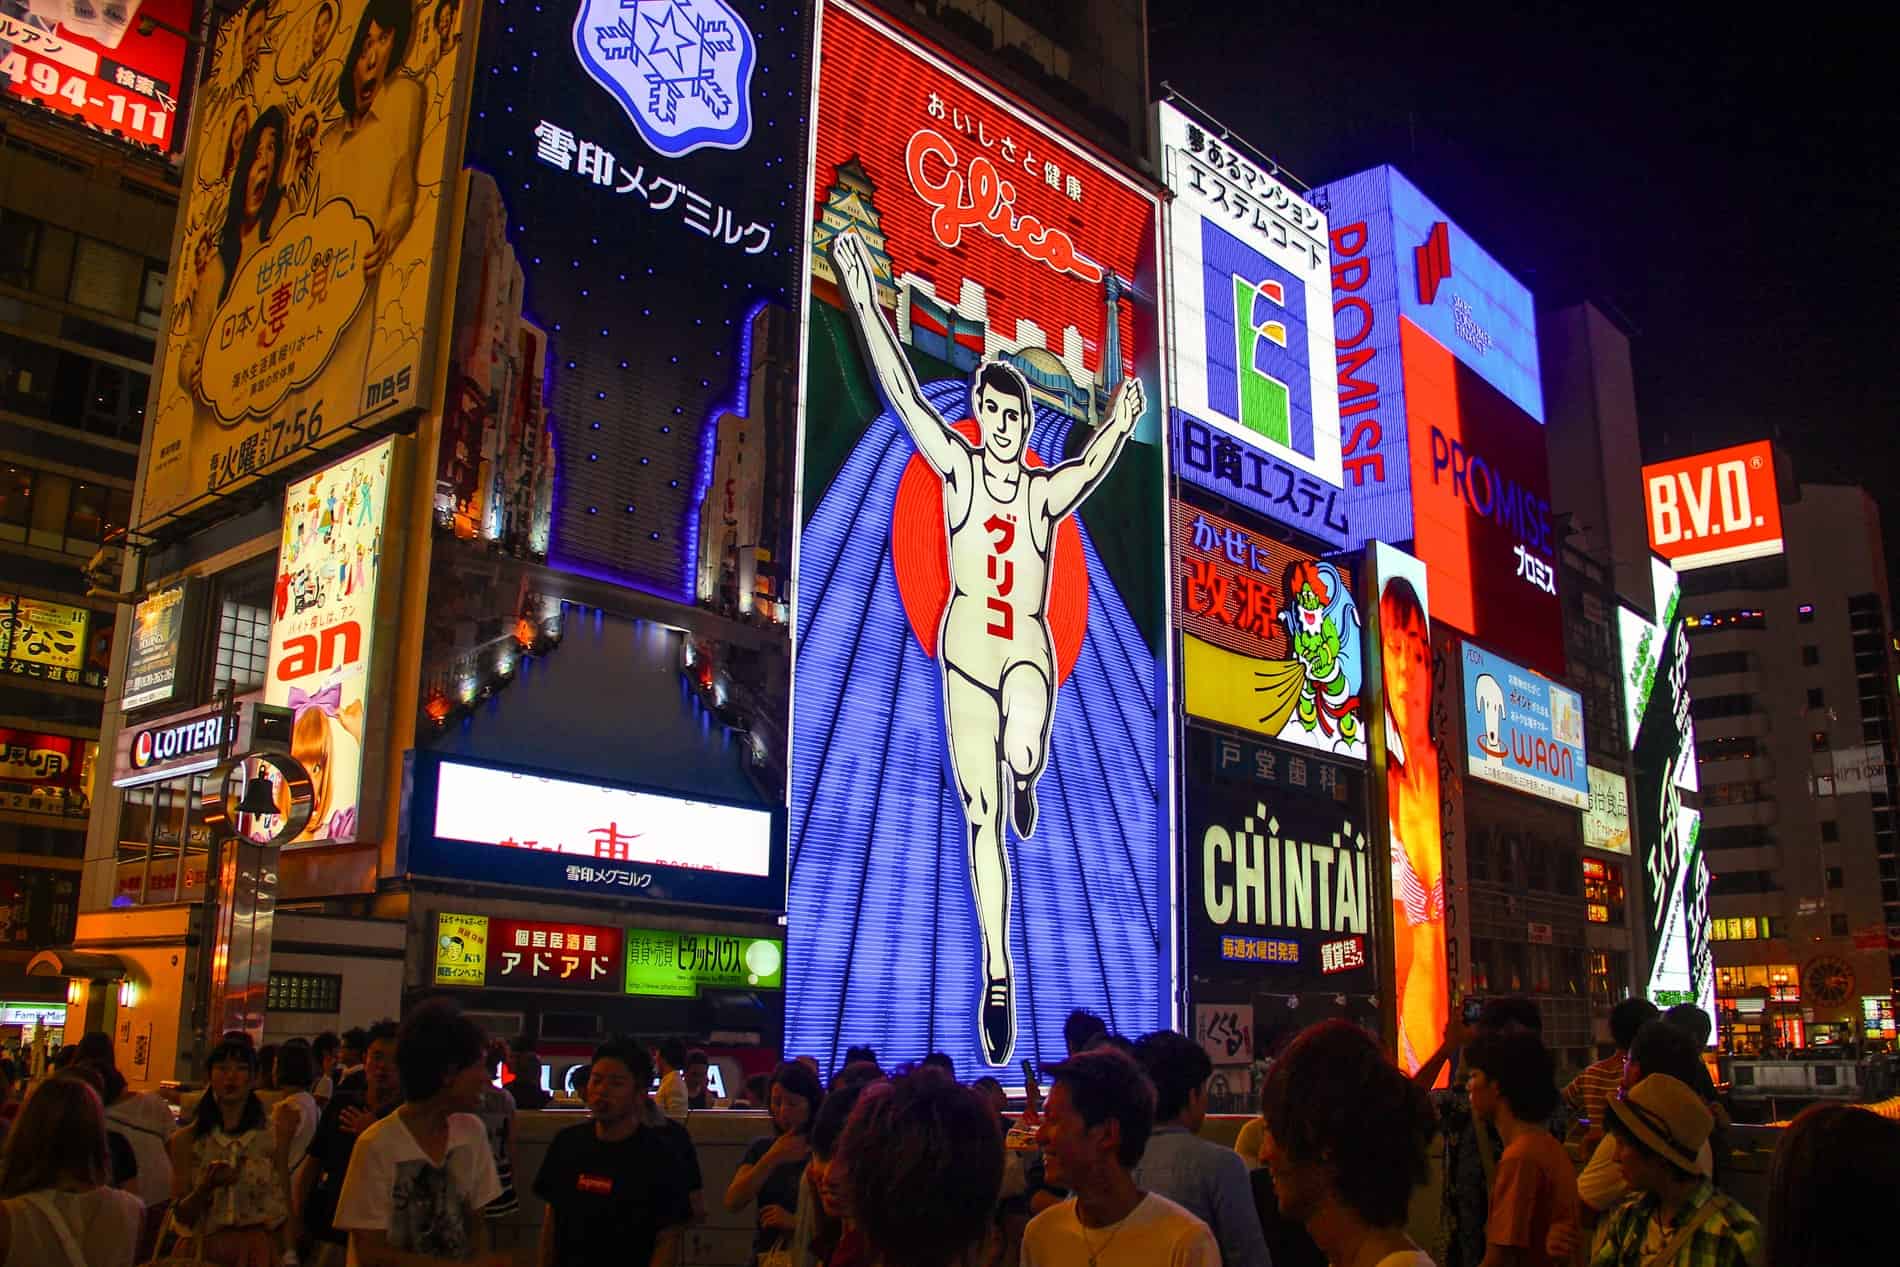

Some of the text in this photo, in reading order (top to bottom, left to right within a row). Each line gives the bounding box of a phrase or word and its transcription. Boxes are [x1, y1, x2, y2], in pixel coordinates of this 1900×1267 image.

[115, 65, 155, 97] 検索
[927, 92, 1082, 202] おいしさと健康
[1187, 123, 1320, 231] 夢あるマンション
[534, 119, 771, 254] 雪印メグミルク
[905, 129, 1102, 283] Glico
[1189, 164, 1322, 270] エステムコート
[270, 399, 325, 462] 7:56
[1183, 418, 1350, 536] 日商エステム
[1430, 424, 1553, 557] PROMISE
[983, 513, 1017, 641] グリコ
[1192, 513, 1271, 576] かぜに
[1513, 543, 1557, 597] プロミス
[1186, 556, 1279, 640] 改源
[276, 620, 362, 682] an
[154, 715, 235, 760] LOTTERI
[1511, 727, 1575, 783] WAON
[565, 864, 652, 888] 雪印メグミルク
[1203, 808, 1368, 934] CHINTAI
[501, 951, 609, 980] アドアド
[514, 928, 597, 952] 個室居酒屋
